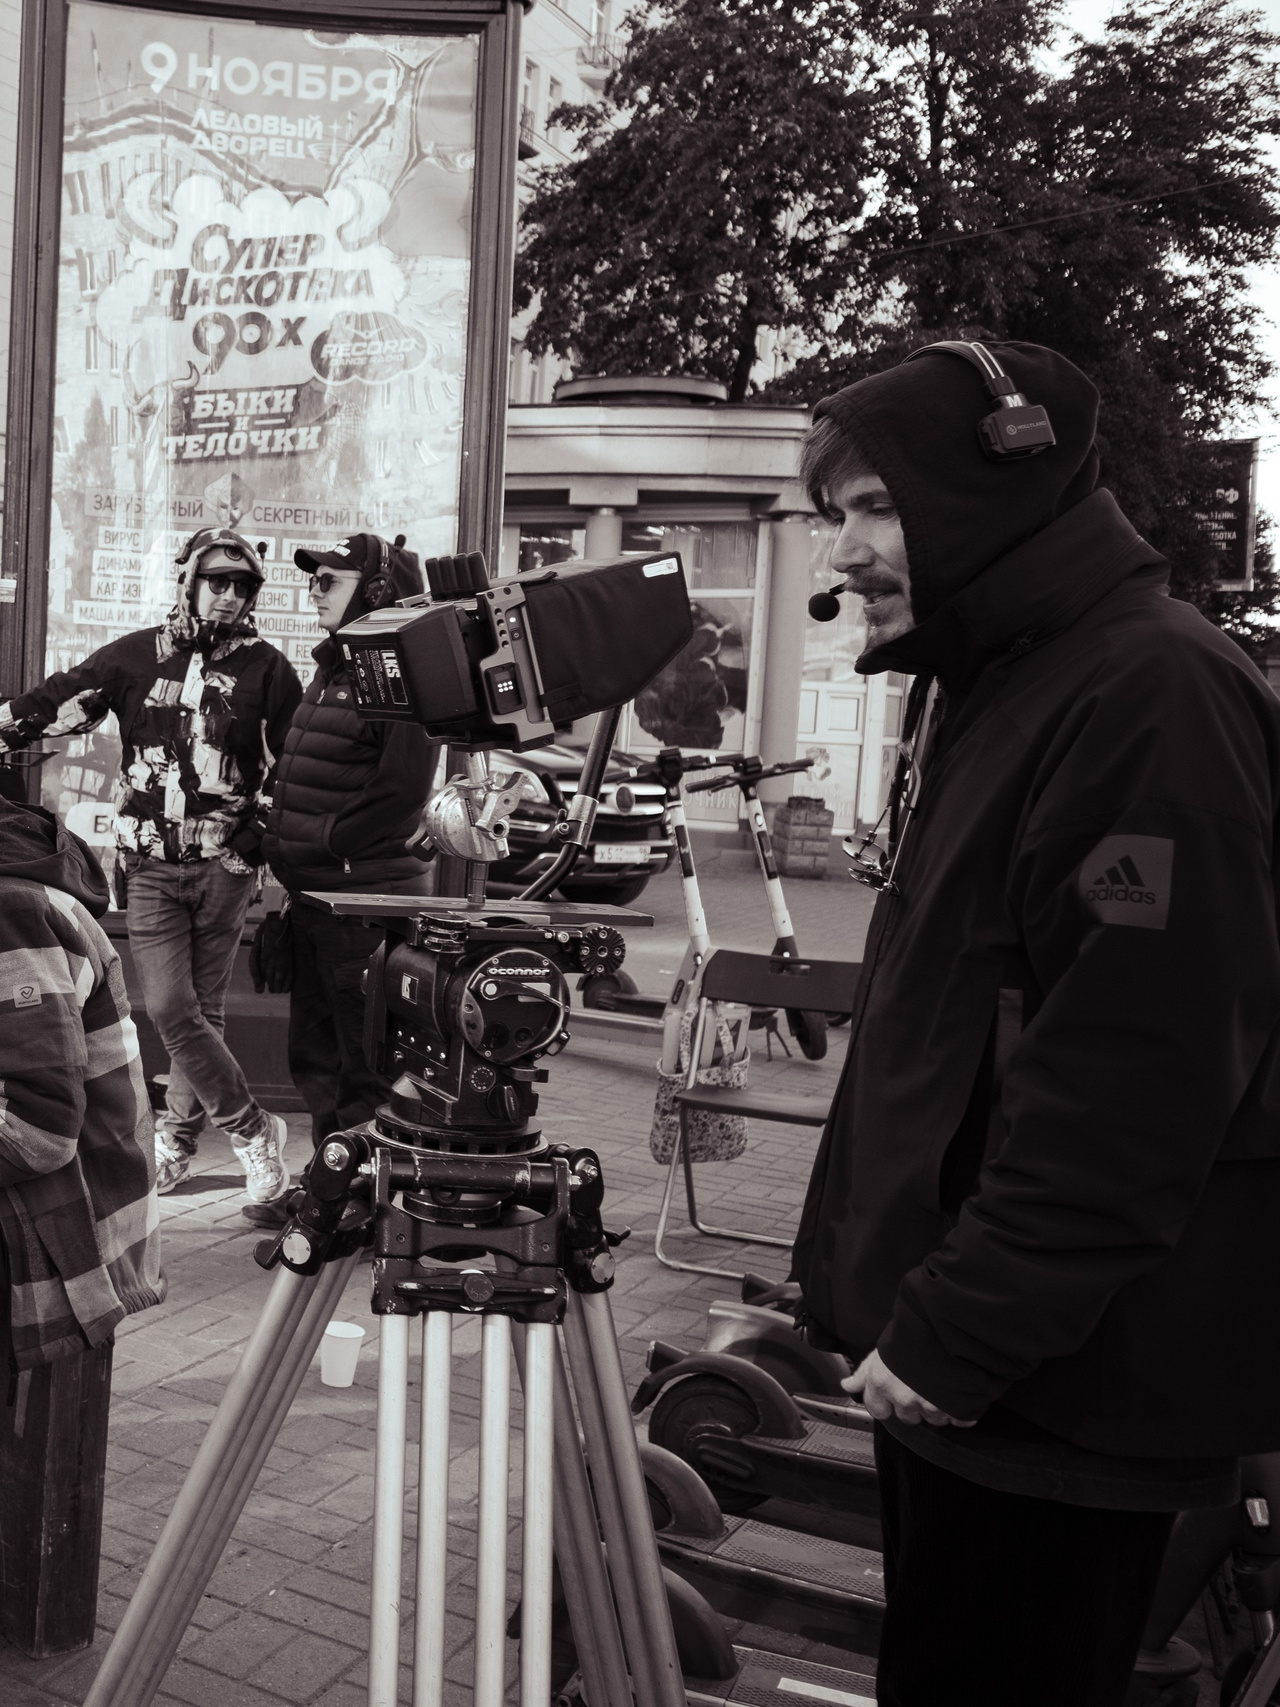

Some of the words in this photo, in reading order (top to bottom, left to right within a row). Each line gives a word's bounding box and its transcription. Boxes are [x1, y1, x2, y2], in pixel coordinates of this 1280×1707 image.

[140, 41, 178, 94] 9
[187, 52, 397, 106] НОЯБРЯ
[190, 107, 324, 141] ЛЕДОВЫЙ
[190, 132, 306, 159] ДВОРЕЦ
[131, 266, 375, 322] ДИСКОТЕКА
[321, 337, 417, 358] RECORD
[329, 356, 368, 367] DANCE
[369, 353, 405, 364] RADIO
[191, 388, 298, 420] БЫКИ
[162, 425, 322, 460] ТЕЛОЧКИ
[252, 505, 351, 528] СЕКРЕТНЫЙ
[104, 529, 141, 547] ВИРУС
[79, 606, 114, 621] МАША
[116, 608, 125, 622] И
[381, 652, 401, 679] LKS
[1086, 885, 1156, 905] adidas
